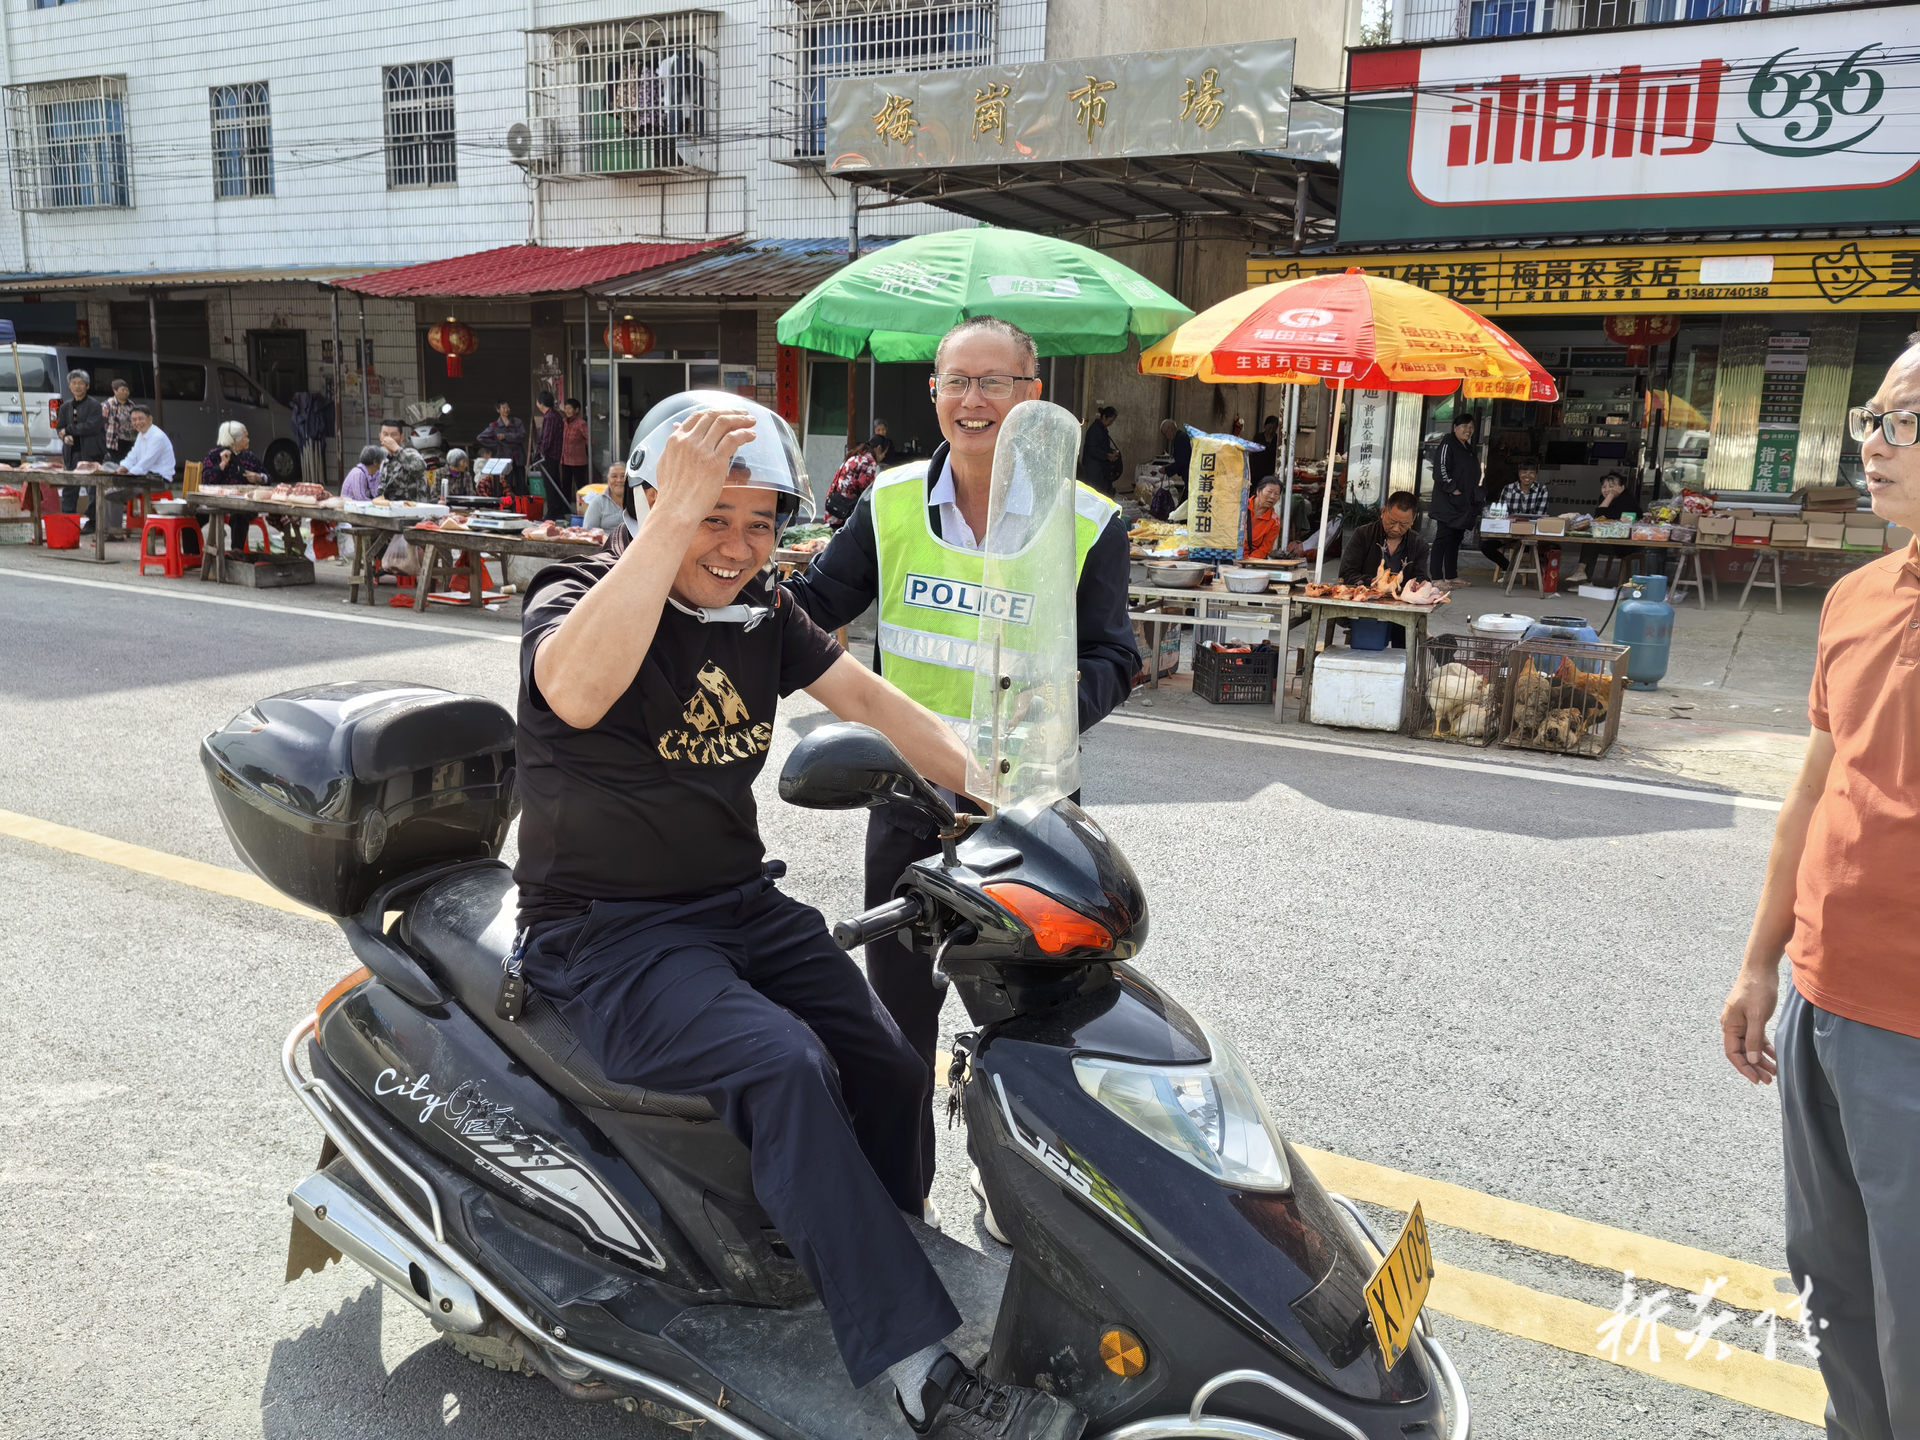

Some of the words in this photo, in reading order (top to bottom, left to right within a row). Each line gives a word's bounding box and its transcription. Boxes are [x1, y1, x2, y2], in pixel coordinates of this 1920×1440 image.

[871, 67, 1225, 146] 梅崗市場
[1511, 259, 1682, 289] 梅岗农家店
[1510, 288, 1571, 303] 厂家直销
[1581, 288, 1643, 302] 批发零售
[1684, 286, 1769, 299] 13487740138
[1253, 328, 1338, 343] 福田五星
[1398, 326, 1482, 344] 福田五星
[1194, 453, 1216, 533] 旺海集团
[910, 579, 1027, 619] POLICE
[374, 1067, 448, 1124] City
[1035, 1135, 1094, 1195] 125
